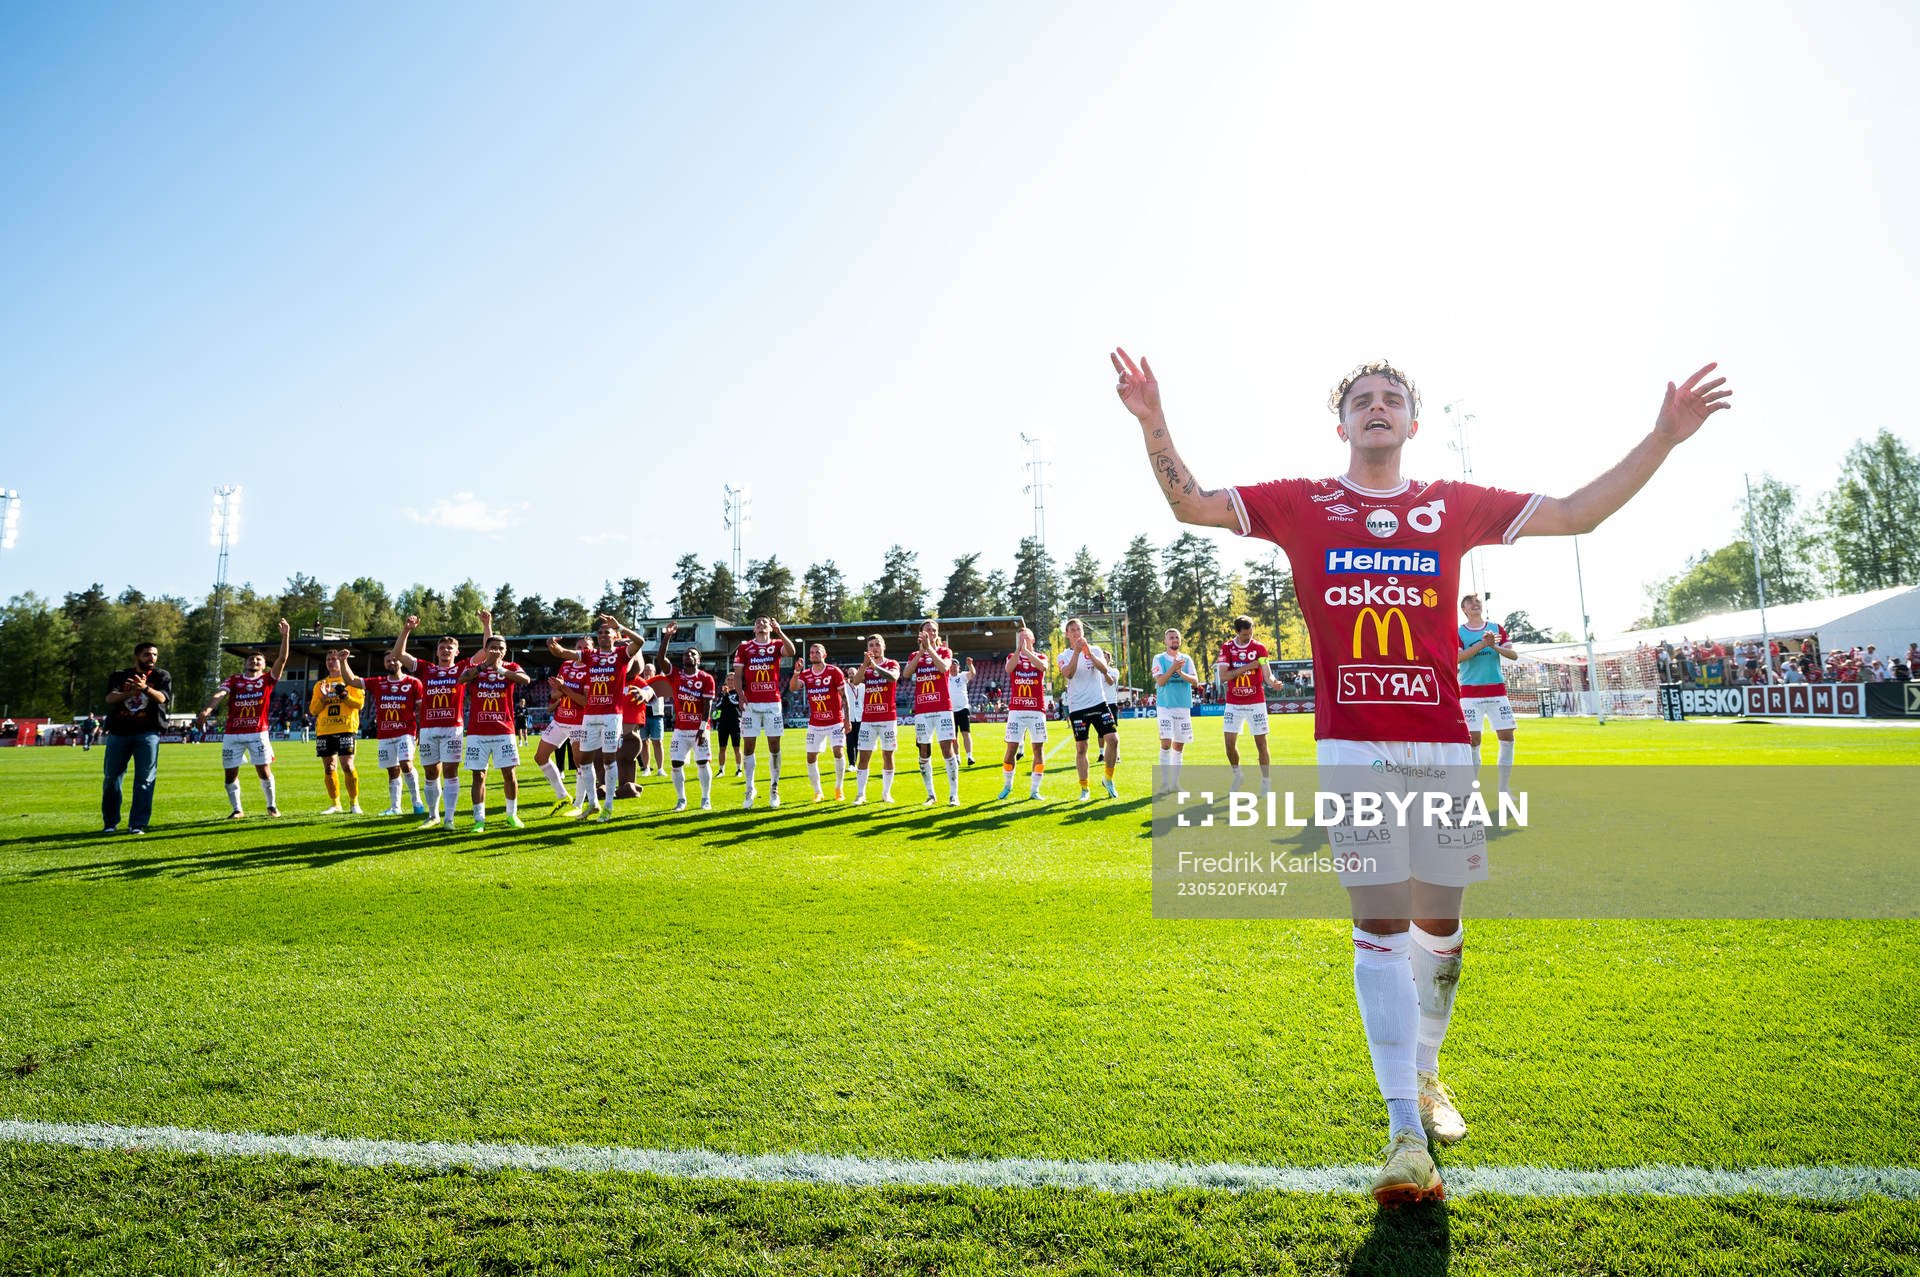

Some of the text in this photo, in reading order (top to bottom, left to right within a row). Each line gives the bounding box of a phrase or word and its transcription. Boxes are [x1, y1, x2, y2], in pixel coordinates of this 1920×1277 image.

[1327, 514, 1354, 522] umbro
[1367, 520, 1397, 528] MHE
[1328, 551, 1436, 573] Helmia
[1324, 576, 1422, 606] askås
[1682, 688, 1742, 713] BESKO
[1752, 691, 1854, 709] CRAMO
[1334, 828, 1391, 843] D-LAB
[1437, 830, 1485, 845] D-LAB
